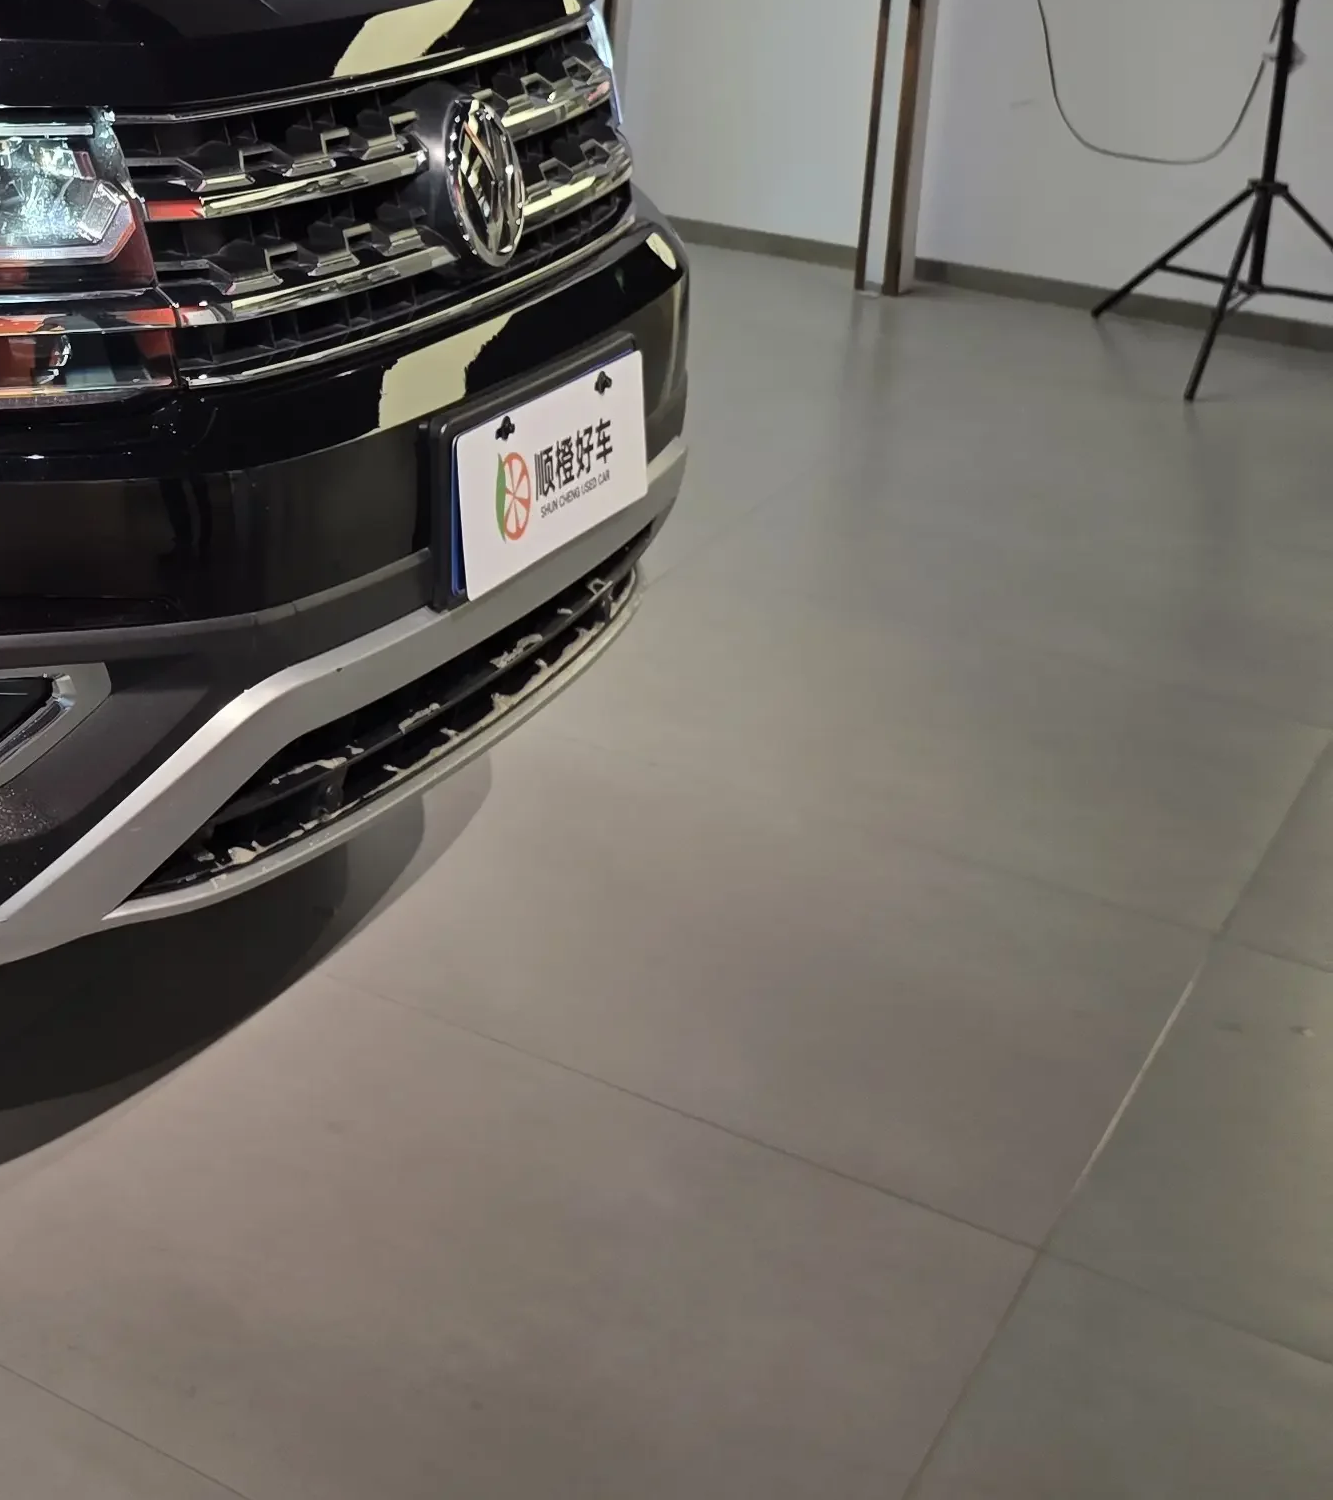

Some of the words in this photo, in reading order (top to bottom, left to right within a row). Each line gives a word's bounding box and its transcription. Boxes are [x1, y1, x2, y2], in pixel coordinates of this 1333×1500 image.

[534, 418, 613, 502] 顺橙好车
[540, 498, 559, 519] SHUN
[558, 486, 581, 508] CHENG
[580, 476, 598, 495] USED
[597, 468, 611, 486] CAR
